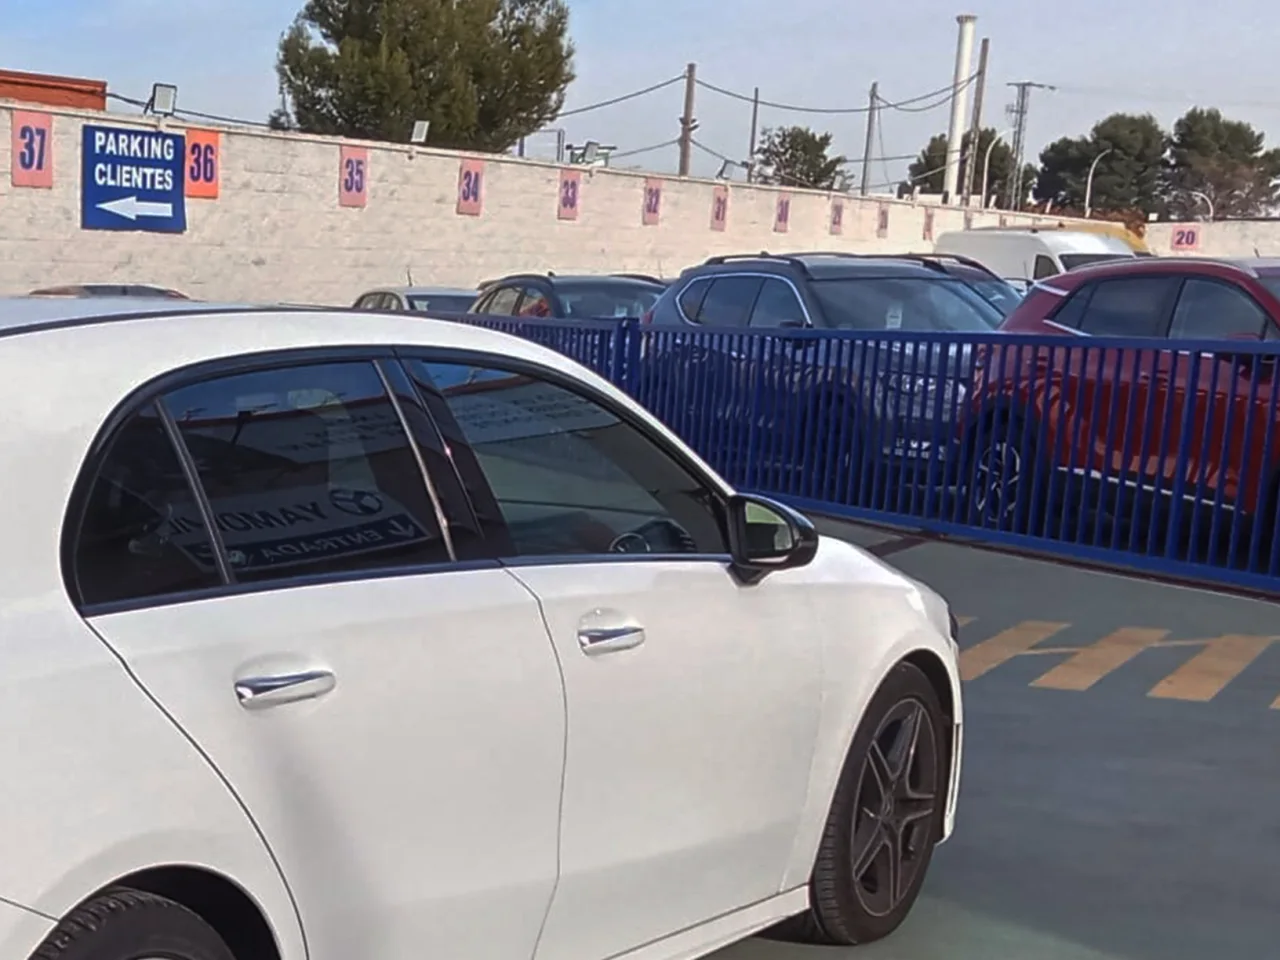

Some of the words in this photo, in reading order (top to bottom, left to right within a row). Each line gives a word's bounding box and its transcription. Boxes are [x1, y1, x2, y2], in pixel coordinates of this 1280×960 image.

[19, 126, 47, 170] 37
[95, 132, 175, 160] PARKING
[95, 165, 173, 191] CLIENTES
[189, 142, 214, 183] 36
[343, 158, 364, 194] 35
[462, 170, 480, 203] 34
[562, 180, 577, 209] 33
[1175, 230, 1196, 246] 20
